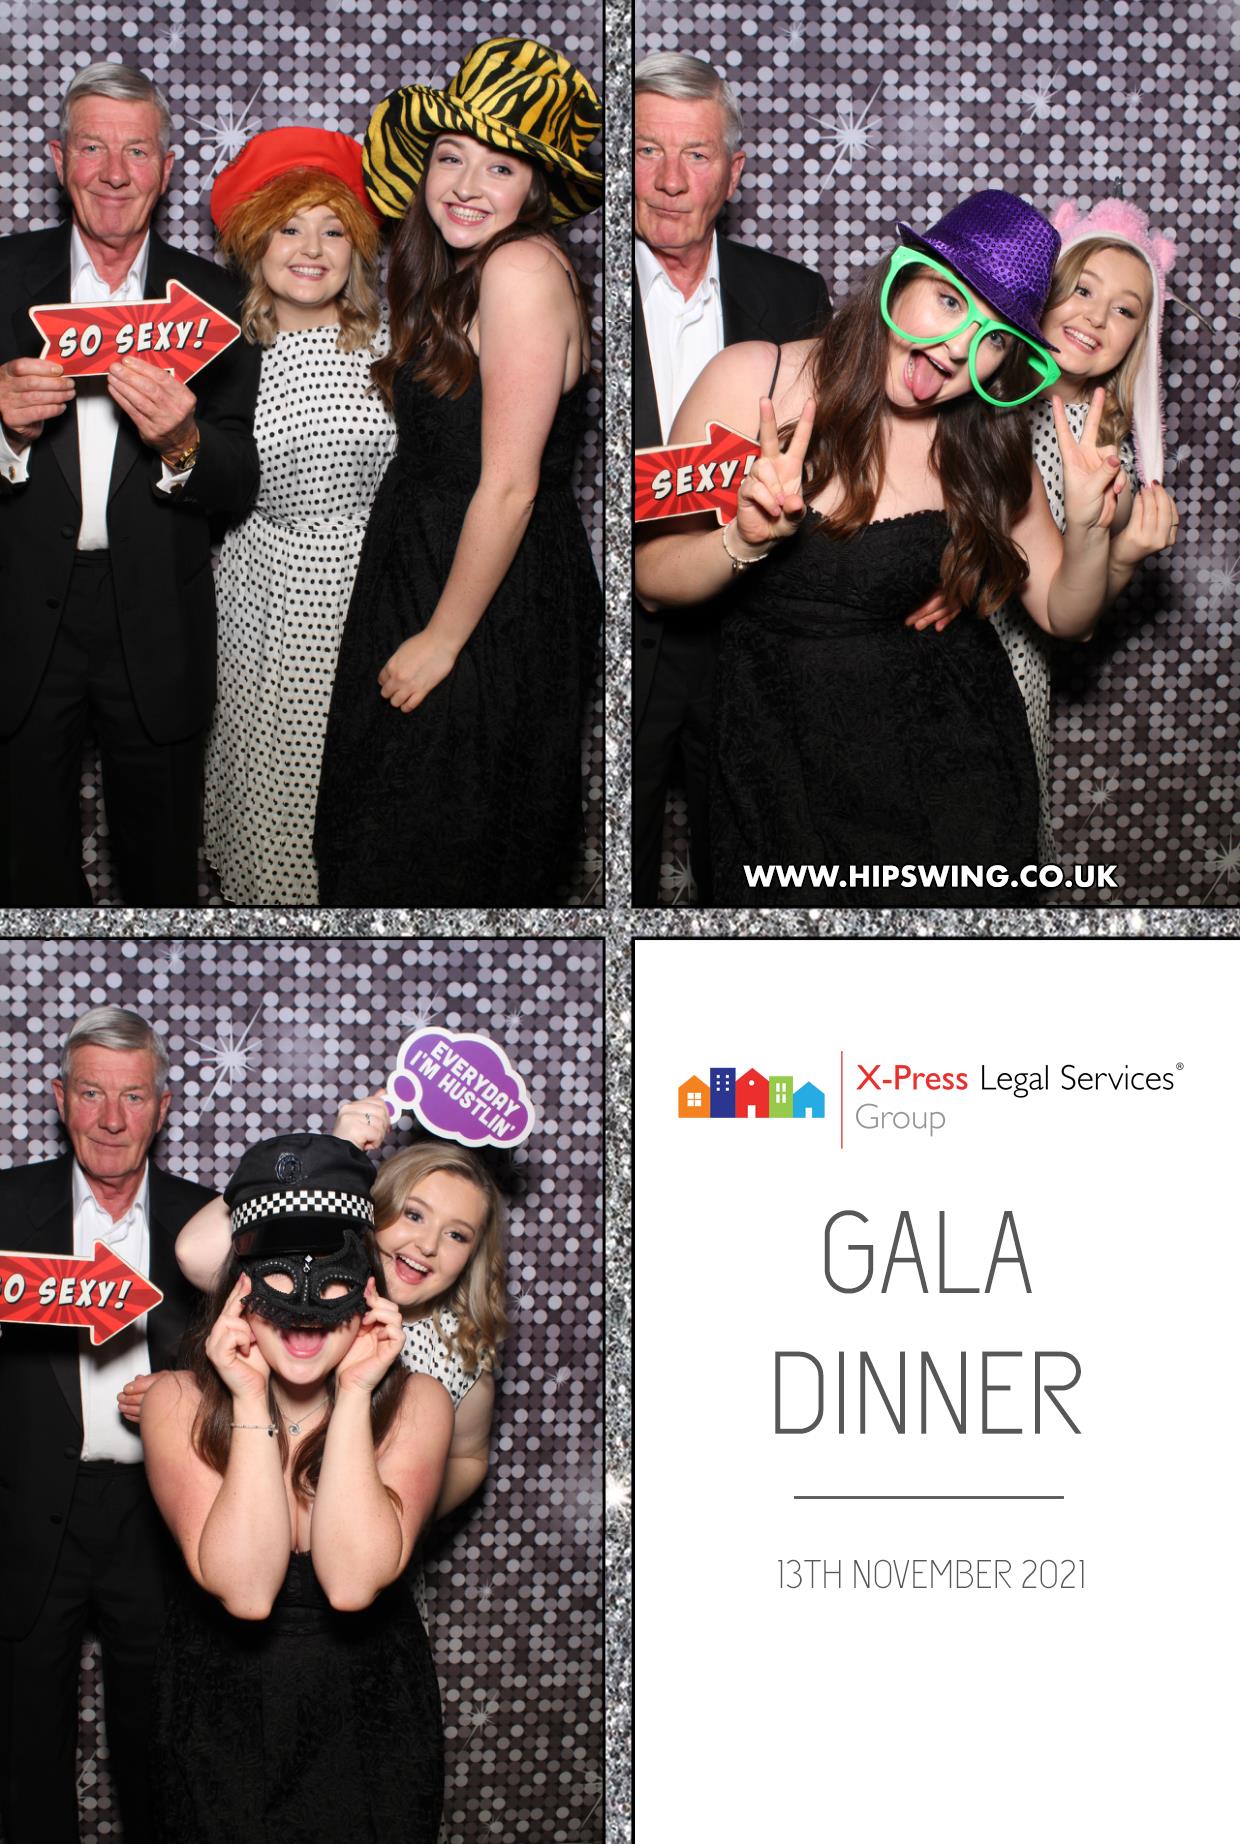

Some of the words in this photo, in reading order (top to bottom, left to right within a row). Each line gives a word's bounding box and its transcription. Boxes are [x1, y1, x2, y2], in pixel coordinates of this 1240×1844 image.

[58, 324, 103, 358] SO
[115, 318, 210, 355] SEXY!
[409, 1050, 441, 1080] I'M
[437, 1073, 516, 1138] HUSTLIN'
[430, 1040, 520, 1117] EVERYDAY
[0, 1273, 26, 1304] O
[38, 1277, 133, 1310] SEXY!
